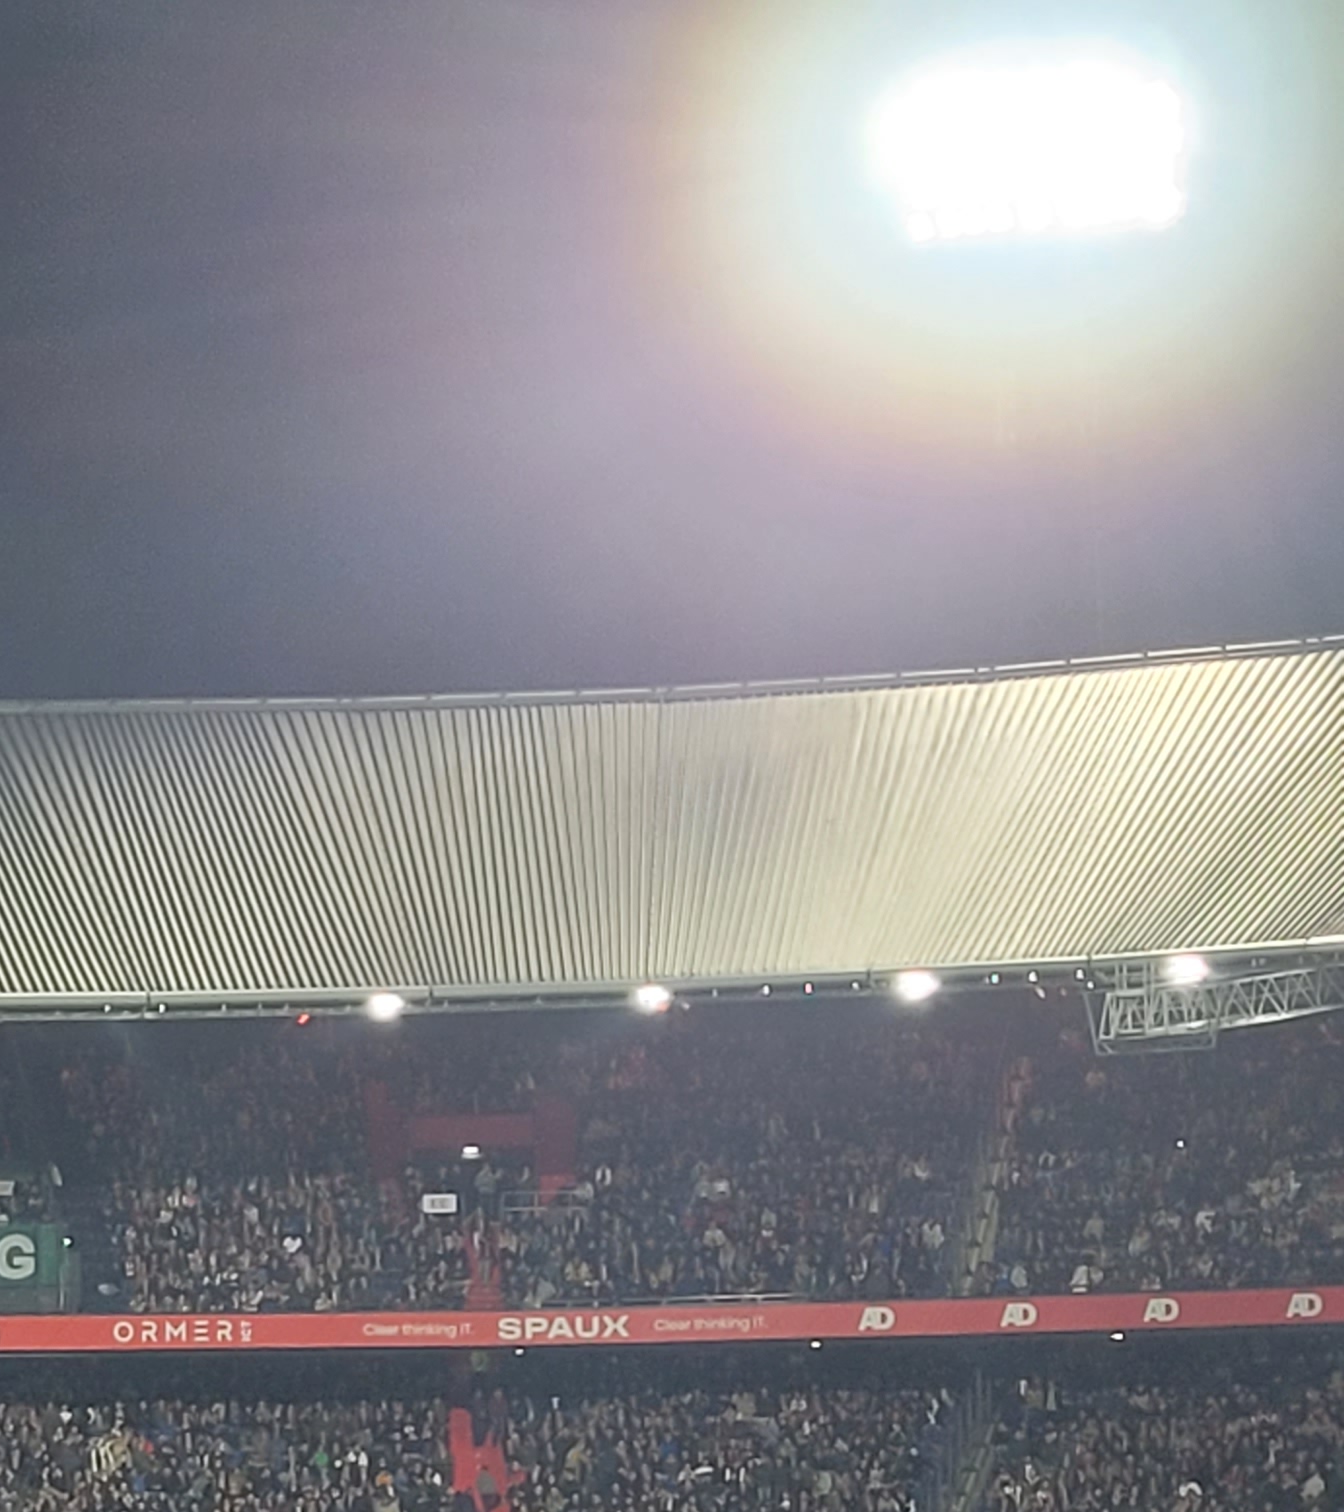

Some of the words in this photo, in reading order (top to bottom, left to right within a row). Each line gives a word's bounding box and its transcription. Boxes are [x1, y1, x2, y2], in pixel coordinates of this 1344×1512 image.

[1001, 1303, 1037, 1327] AD
[1144, 1298, 1179, 1322] AD
[1286, 1293, 1322, 1318] AD
[497, 1315, 629, 1340] SPAUX
[858, 1306, 895, 1331] AD
[113, 1320, 232, 1343] ORMER
